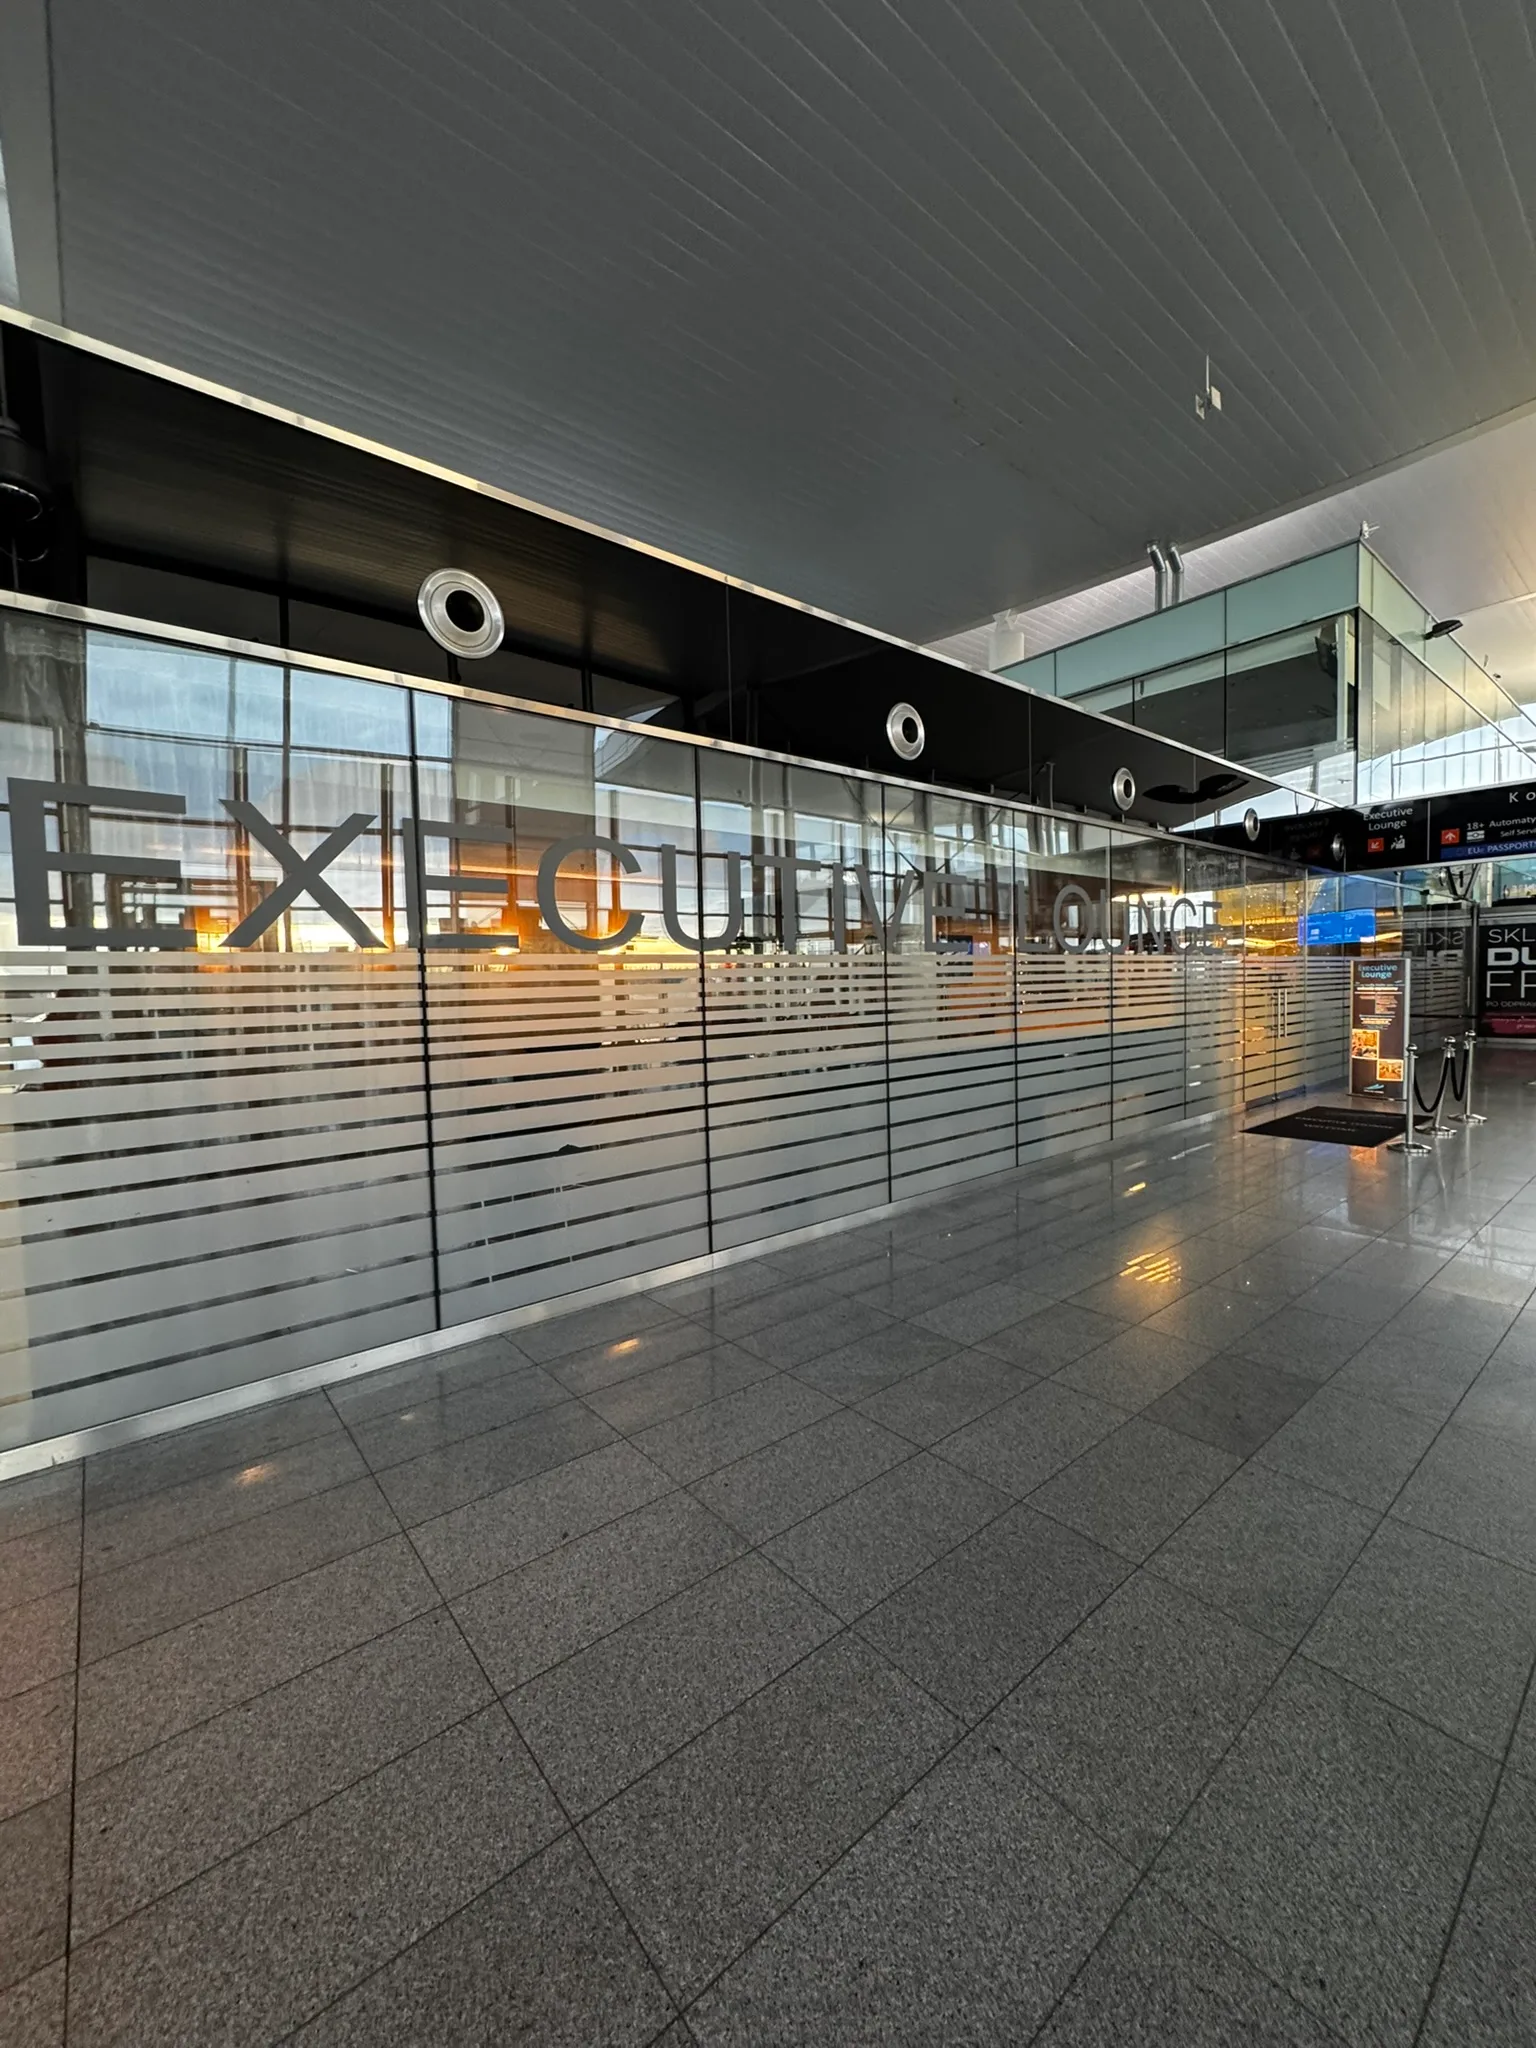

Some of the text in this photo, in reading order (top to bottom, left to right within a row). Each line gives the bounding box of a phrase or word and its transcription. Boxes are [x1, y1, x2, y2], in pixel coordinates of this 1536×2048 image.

[1363, 807, 1413, 821] Executive
[1368, 819, 1407, 831] Lounge
[1466, 822, 1485, 830] 18+
[7, 777, 1224, 955] EXECUTIVE LOUNGE
[1358, 964, 1398, 972] Executive
[1361, 971, 1393, 979] Lounge
